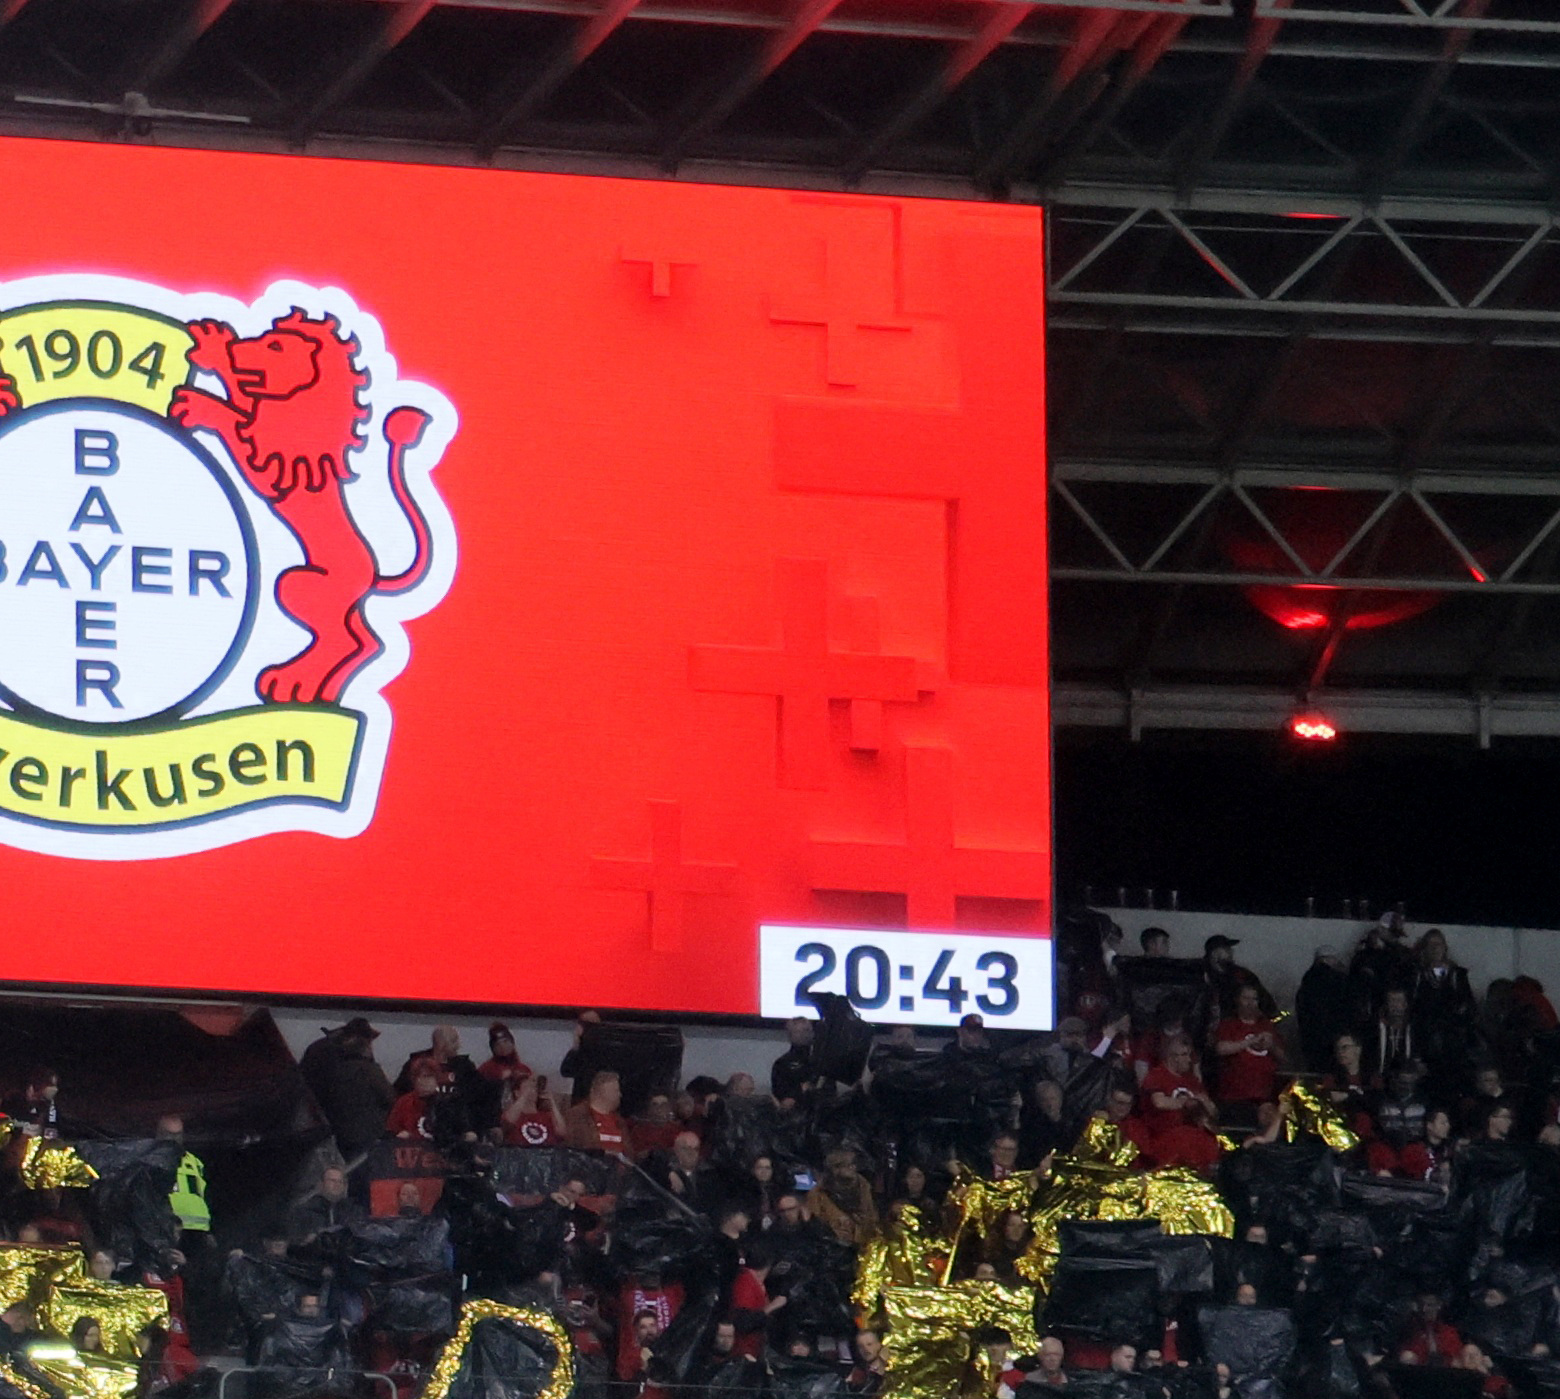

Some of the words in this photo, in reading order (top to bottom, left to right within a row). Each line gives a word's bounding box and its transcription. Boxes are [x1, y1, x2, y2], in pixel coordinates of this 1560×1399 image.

[15, 329, 167, 390] 1904
[68, 427, 126, 711] BAYER
[794, 942, 1020, 1016] 20:43
